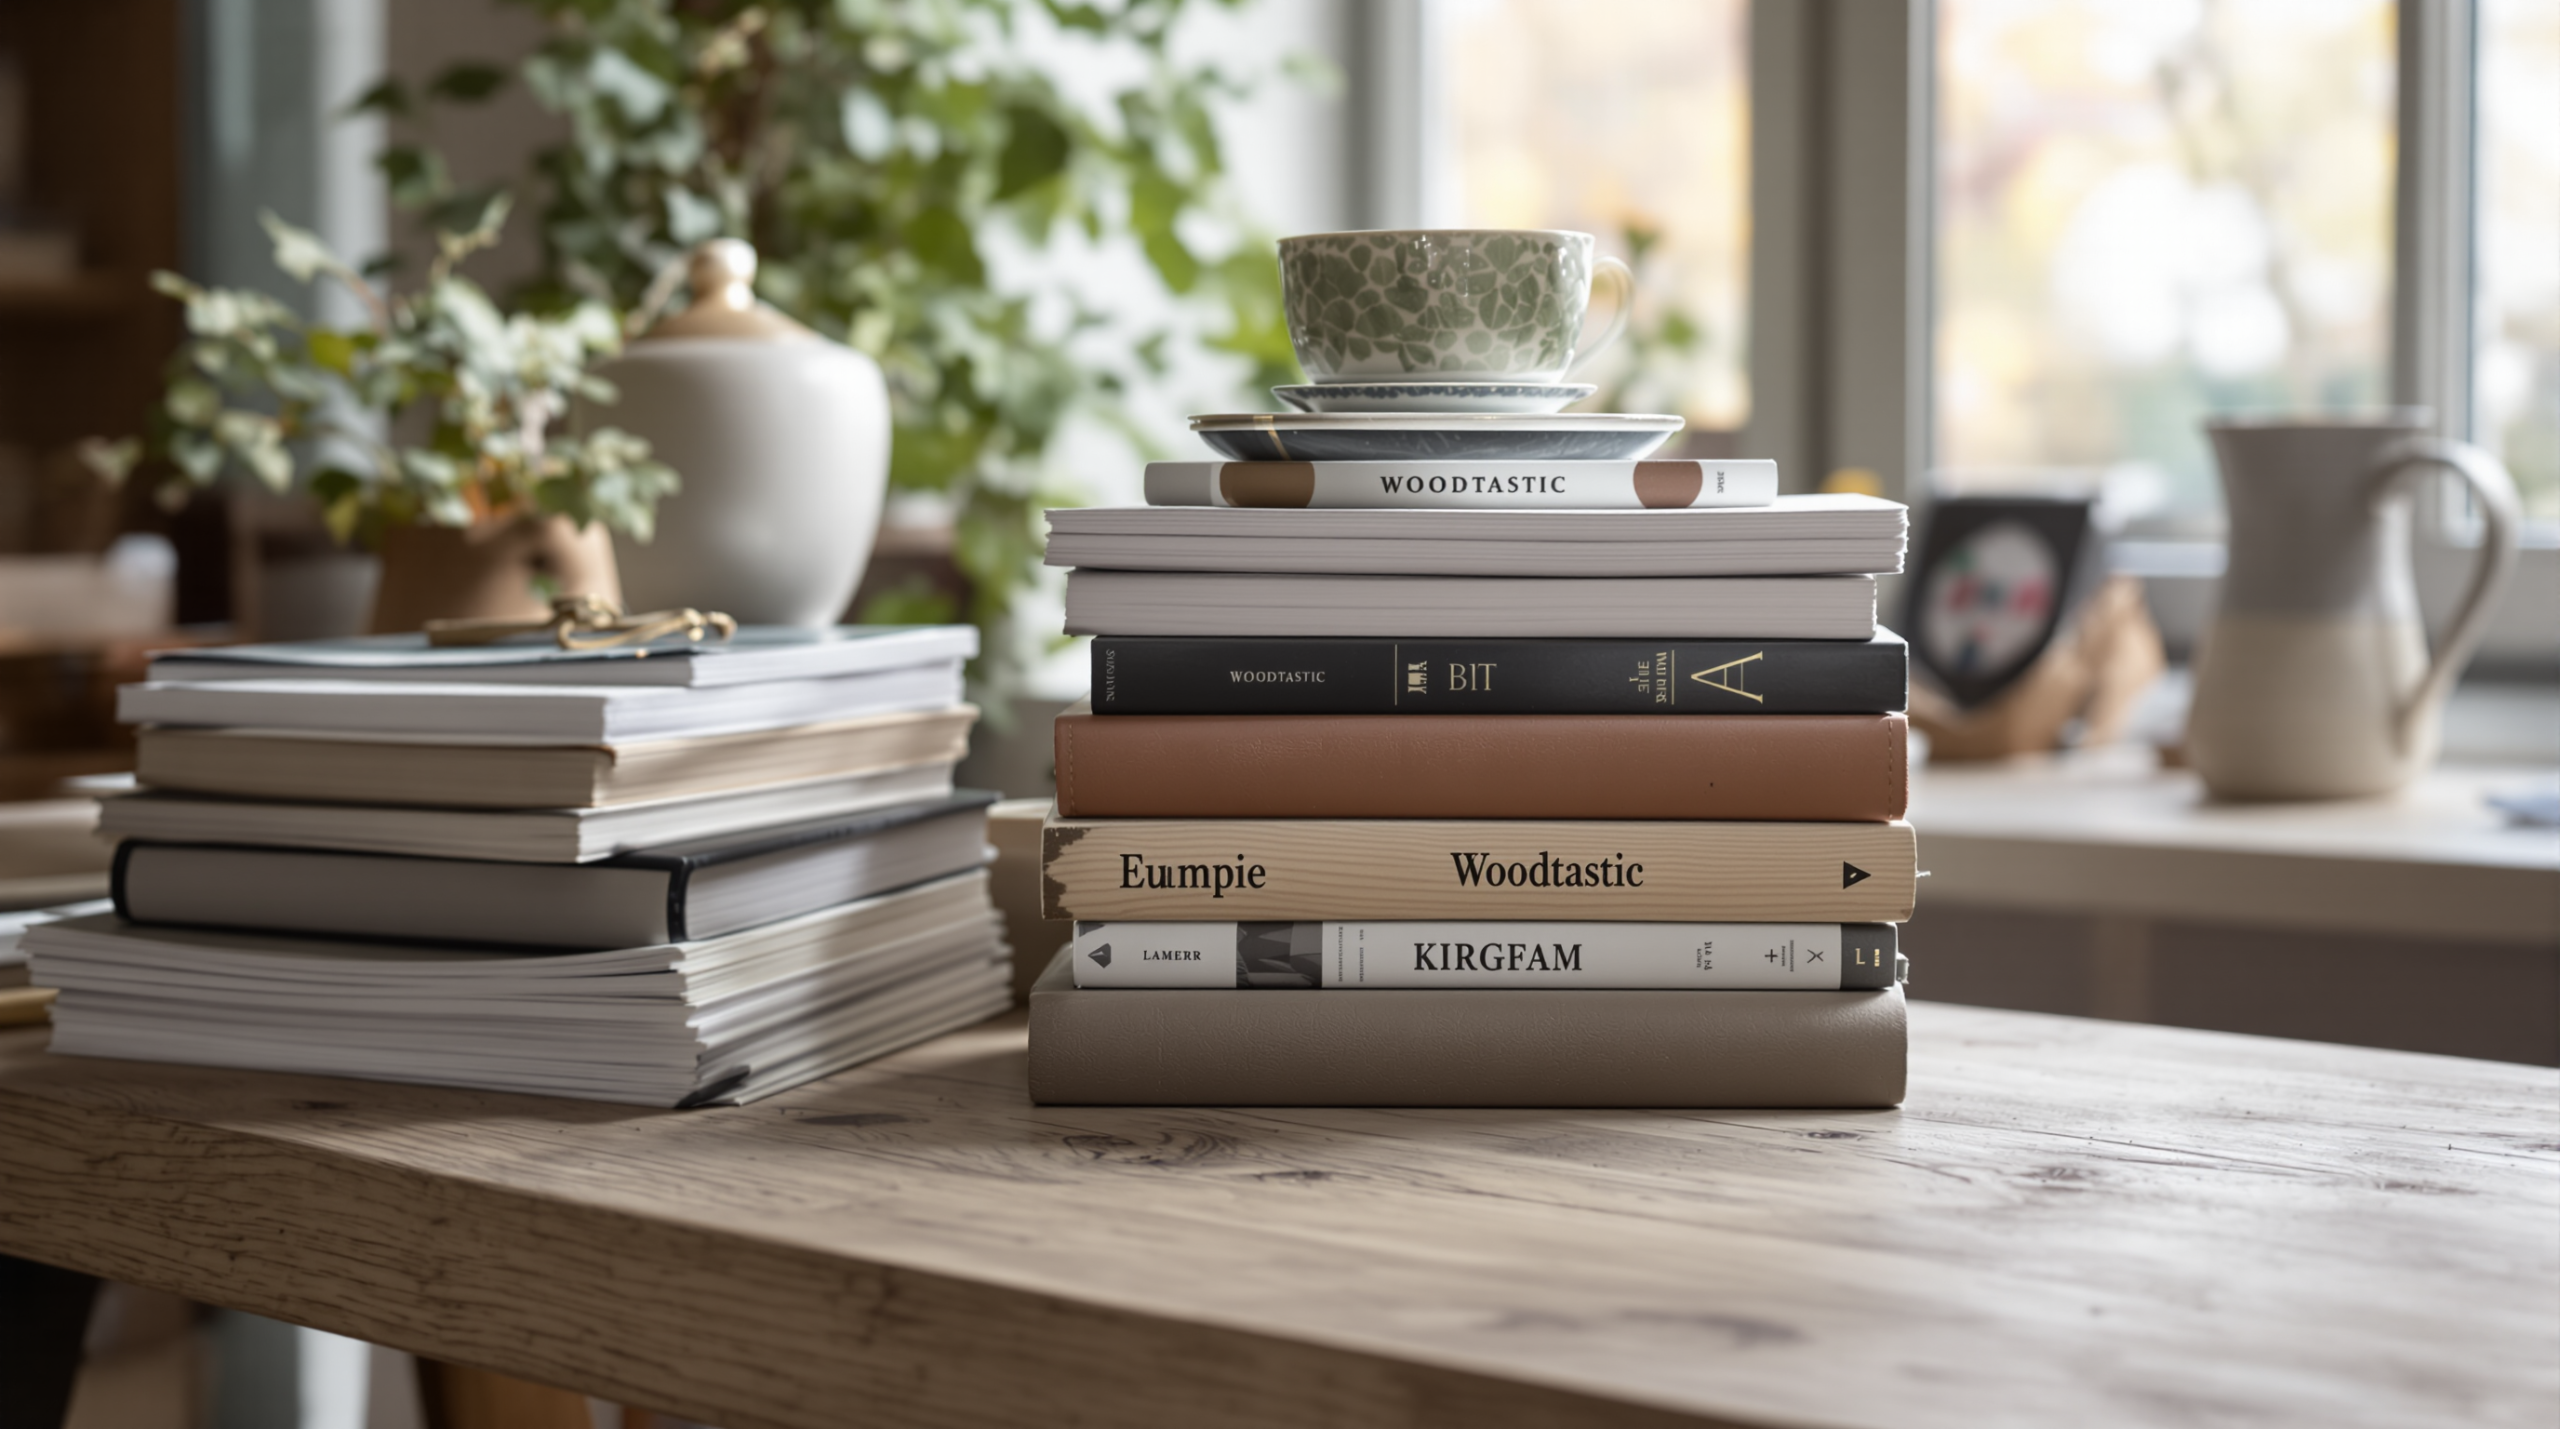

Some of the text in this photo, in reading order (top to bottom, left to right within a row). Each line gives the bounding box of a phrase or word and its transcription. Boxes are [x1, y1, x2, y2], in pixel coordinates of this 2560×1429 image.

[1380, 474, 1568, 495] WOODTASTIC
[1229, 670, 1326, 683] WOODTASTIC
[1448, 662, 1498, 691] BIT
[1449, 850, 1645, 888] Woodtastic
[1143, 950, 1202, 962] LAMERR
[1413, 942, 1584, 972] KIRGFAM
